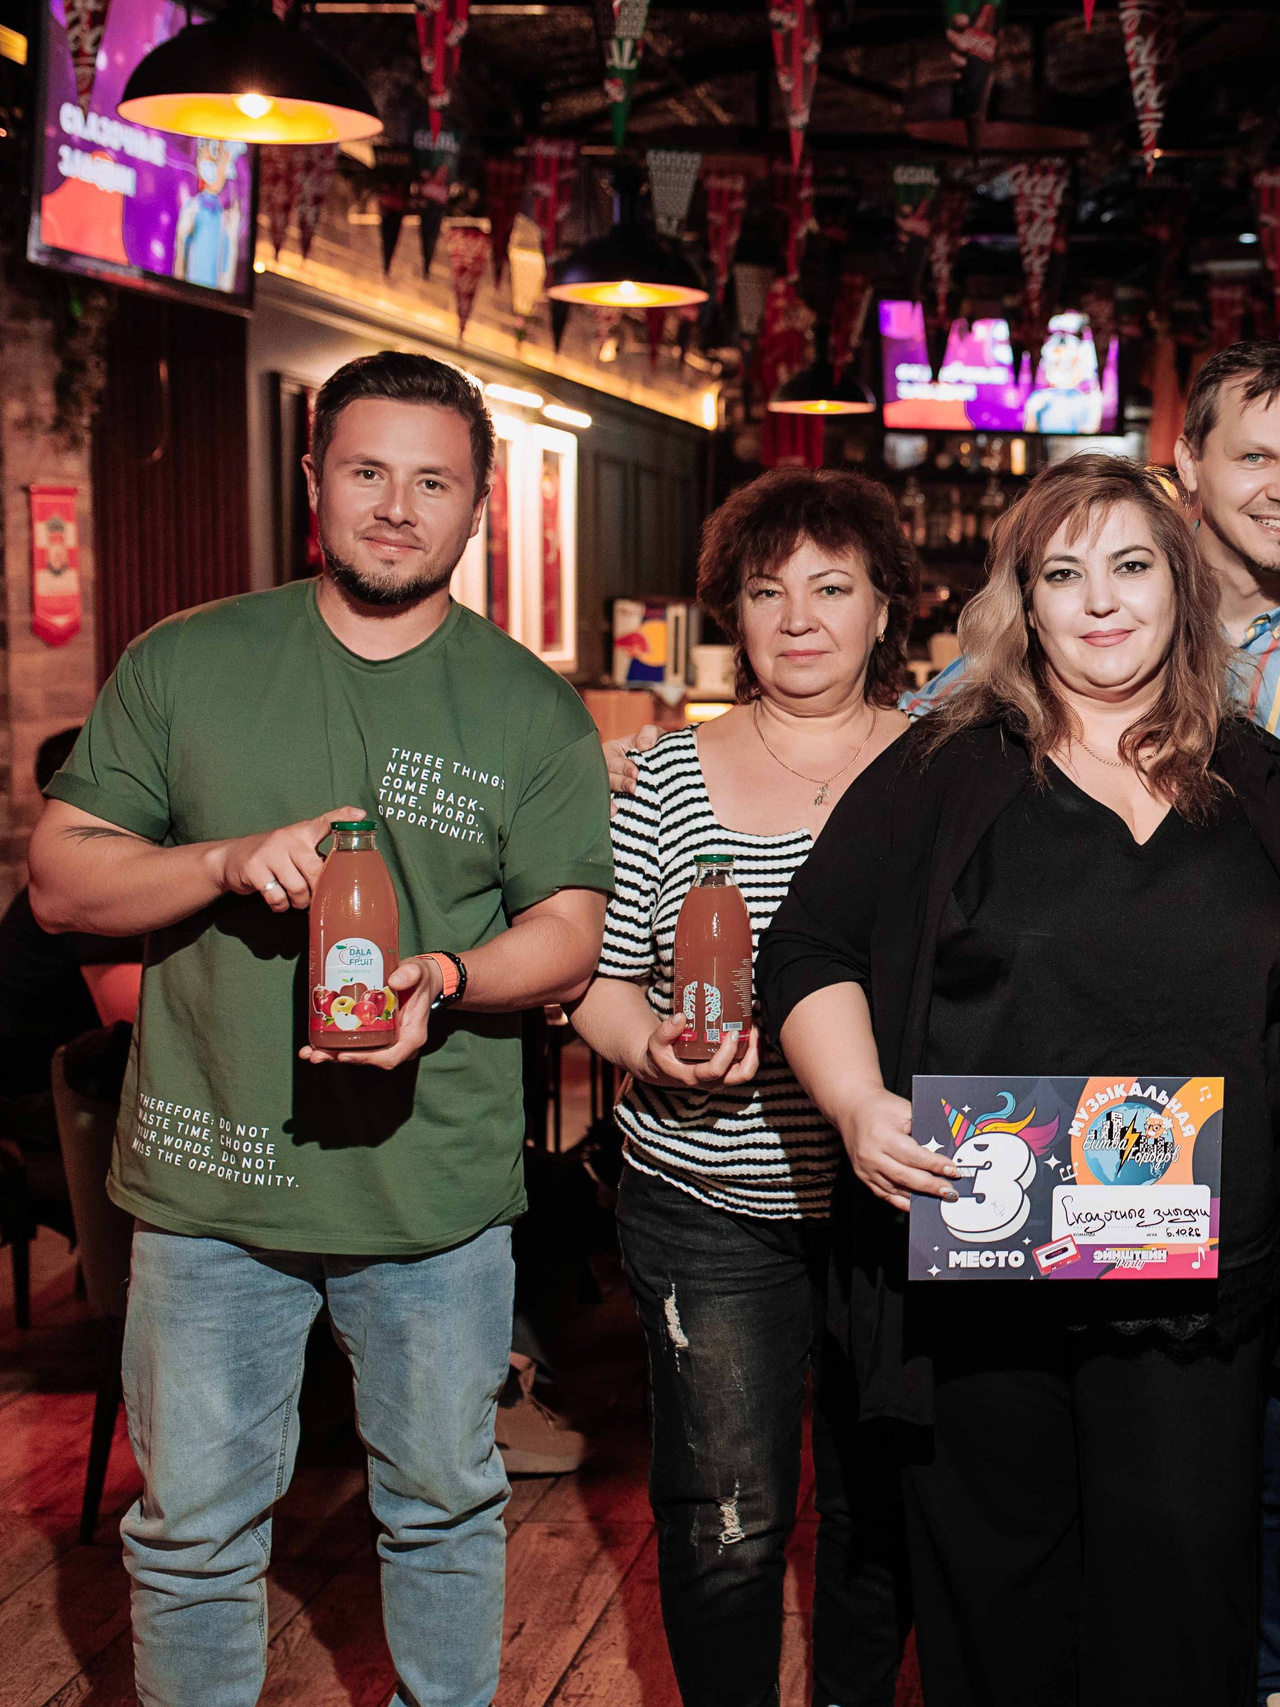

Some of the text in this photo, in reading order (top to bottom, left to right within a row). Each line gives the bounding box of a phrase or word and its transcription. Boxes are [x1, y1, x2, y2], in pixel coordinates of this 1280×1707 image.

[386, 762, 442, 784] NEVER
[391, 747, 505, 790] THREE THINGS
[382, 775, 485, 811] COME BACK-
[378, 804, 486, 844] OPPORTUNITY.
[349, 948, 372, 956] DALA
[349, 958, 374, 966] FRUIT
[139, 1093, 270, 1139] THEREFORE: DO NOT
[1067, 1082, 1196, 1138] МУЗЫКАЛЬНАЯ
[137, 1108, 171, 1131] WASTE
[220, 1134, 276, 1155] CHOOSE
[131, 1137, 300, 1188] MISS THE OPPORTUNITY.
[221, 1150, 236, 1165] DO
[242, 1157, 276, 1171] NOT
[1061, 1195, 1145, 1234] Сказочные
[948, 1250, 1025, 1269] МЕСТО
[1093, 1248, 1168, 1261] ЭЙНШТЕЙН
[1115, 1258, 1146, 1269] Party
